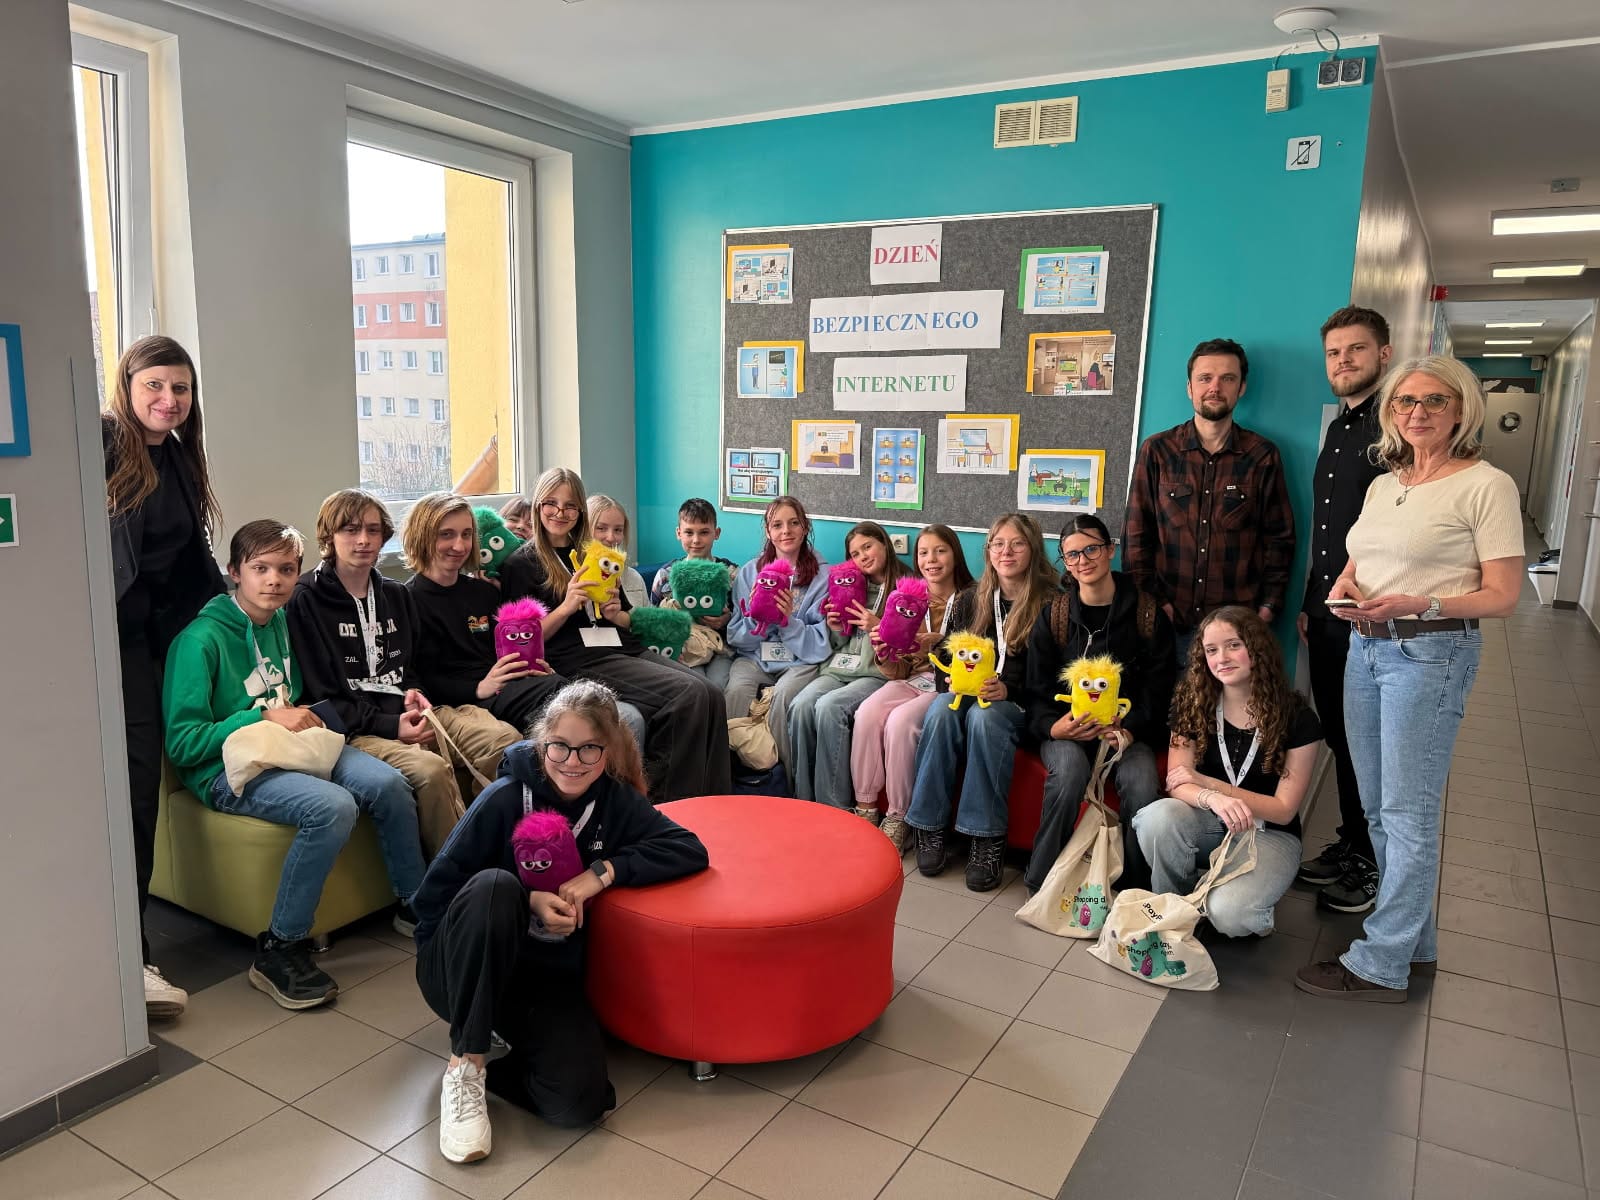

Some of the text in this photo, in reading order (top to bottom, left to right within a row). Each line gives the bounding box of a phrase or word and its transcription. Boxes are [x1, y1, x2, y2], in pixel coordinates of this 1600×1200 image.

[873, 238, 940, 265] DZIEŃ
[812, 310, 979, 334] BEZPIECZNEGO
[836, 374, 957, 393] INTERNETU
